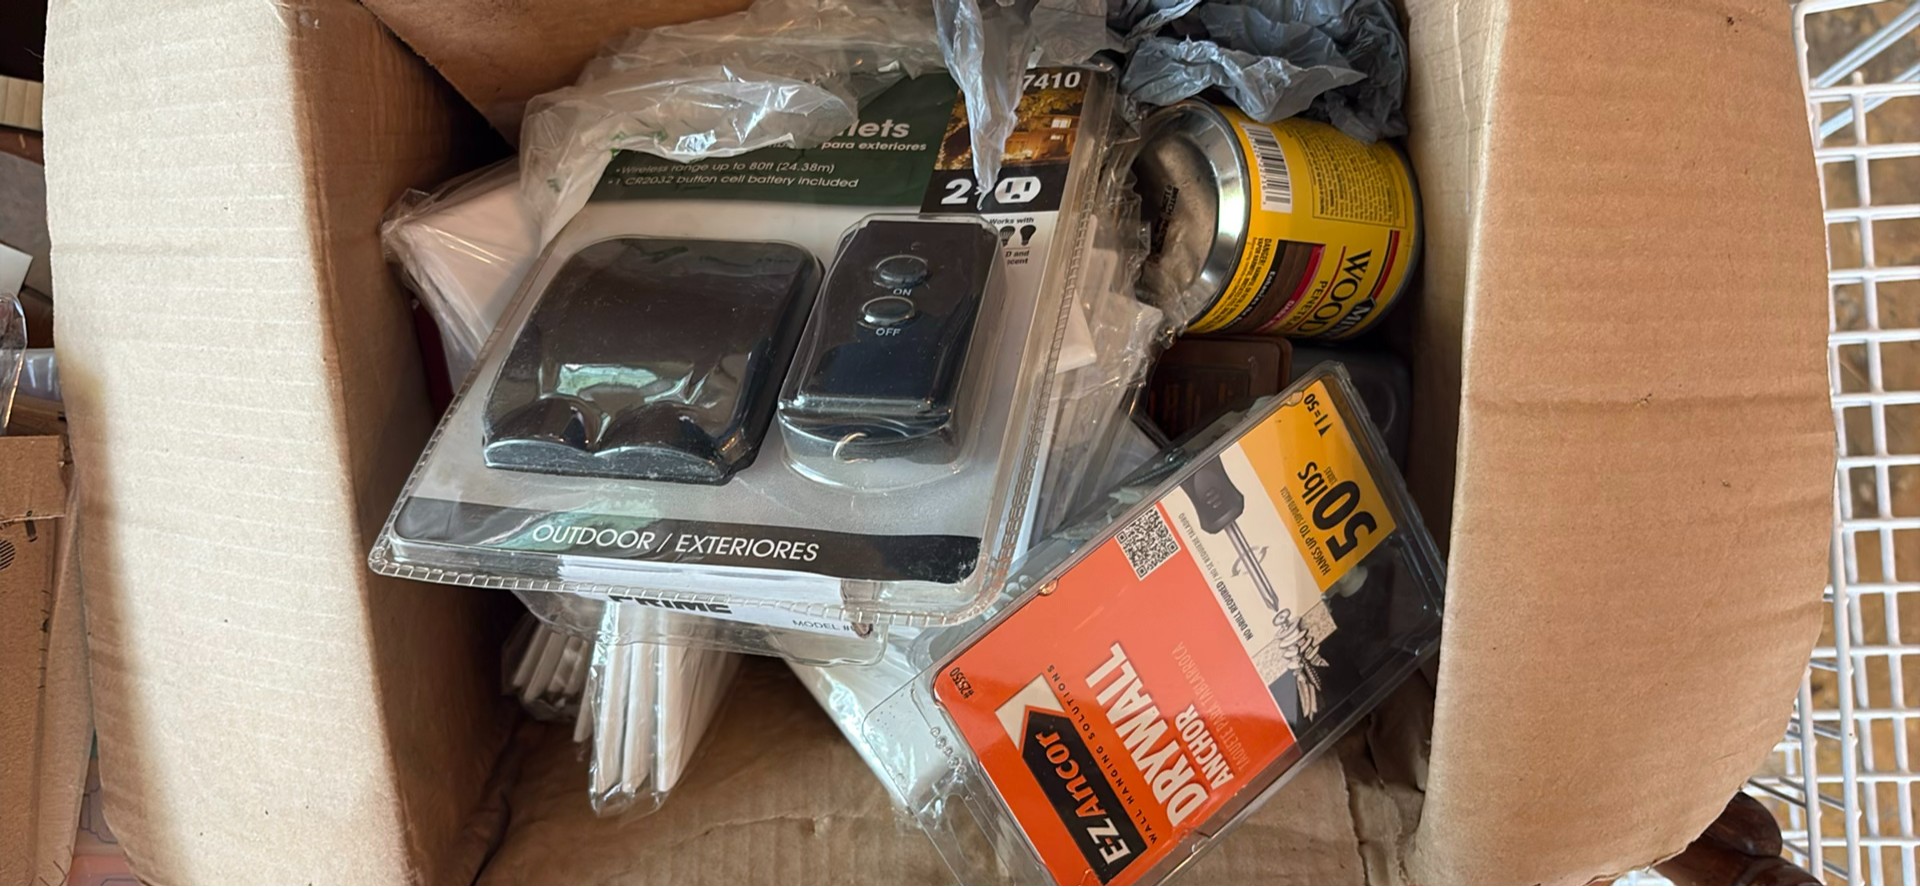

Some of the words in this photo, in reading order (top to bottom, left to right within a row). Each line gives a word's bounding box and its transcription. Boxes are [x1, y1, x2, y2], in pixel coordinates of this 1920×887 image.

[821, 142, 854, 150] para
[859, 141, 927, 151] exteriores
[622, 164, 668, 174] Wireless
[671, 163, 709, 173] range
[712, 162, 729, 171] up
[733, 161, 746, 170] to
[749, 162, 774, 171] 80ft
[776, 162, 835, 174] (24.38m)
[624, 176, 674, 186] CR2032
[676, 175, 717, 184] button
[720, 175, 746, 184] cell
[748, 175, 796, 186] battery
[798, 176, 859, 188] included
[893, 288, 912, 296] ON
[1297, 249, 1372, 333] WOOD
[875, 327, 902, 336] OFF
[1298, 524, 1311, 537] TO
[1304, 535, 1318, 549] UP
[533, 524, 656, 551] OUTDOOR
[676, 534, 820, 562] EXTERIORES
[1206, 561, 1214, 569] SE
[1310, 546, 1332, 574] HANGS
[1209, 568, 1219, 578] NO
[1216, 580, 1238, 612] REQUIRED
[792, 619, 840, 630] MODEL
[1232, 610, 1248, 629] DRILL
[1243, 628, 1253, 639] NO
[1170, 641, 1214, 705] TABLARROCA
[1047, 664, 1096, 741] SOLUTIONS
[1205, 703, 1230, 732] PARA
[1085, 641, 1210, 828] DRYWALL
[1175, 704, 1235, 789] ANCHOR
[1219, 728, 1251, 770] TAQUETE
[1096, 745, 1135, 805] HANGING
[1134, 808, 1158, 844] WALL
